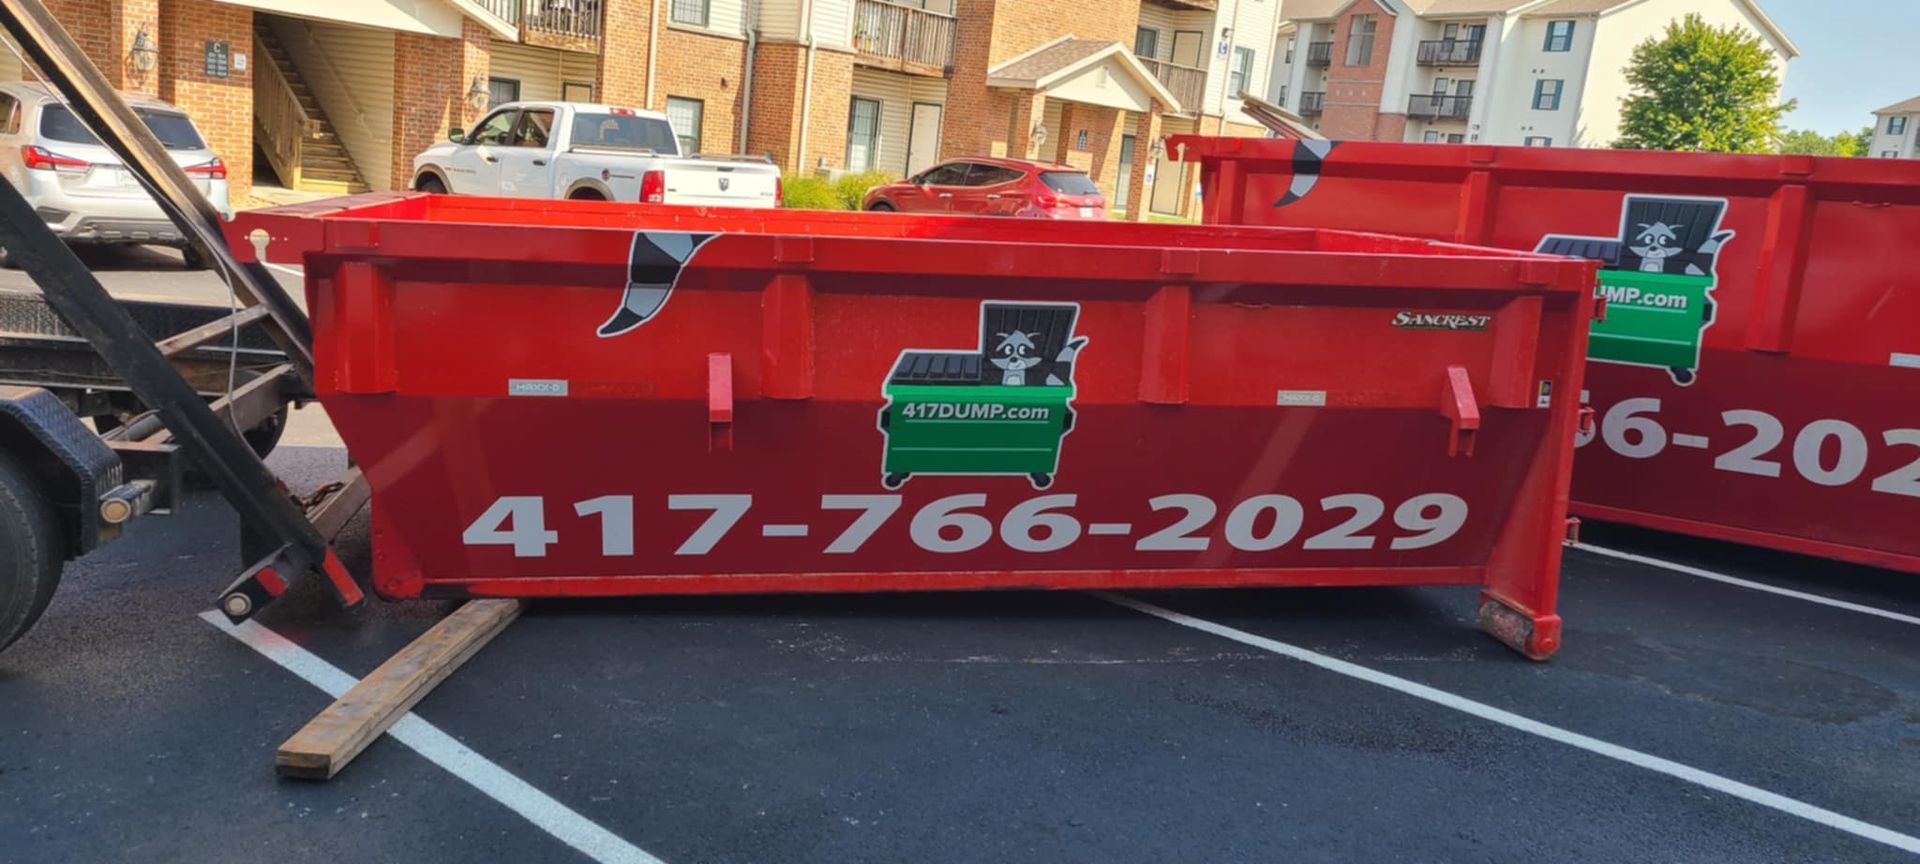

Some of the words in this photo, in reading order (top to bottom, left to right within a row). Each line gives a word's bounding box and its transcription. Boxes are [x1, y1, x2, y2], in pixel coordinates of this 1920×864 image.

[1392, 310, 1491, 329] SANCREST
[902, 402, 1050, 420] 417DUMP.com
[1574, 389, 1920, 498] 6-202
[462, 492, 1468, 558] 417-766-2029
